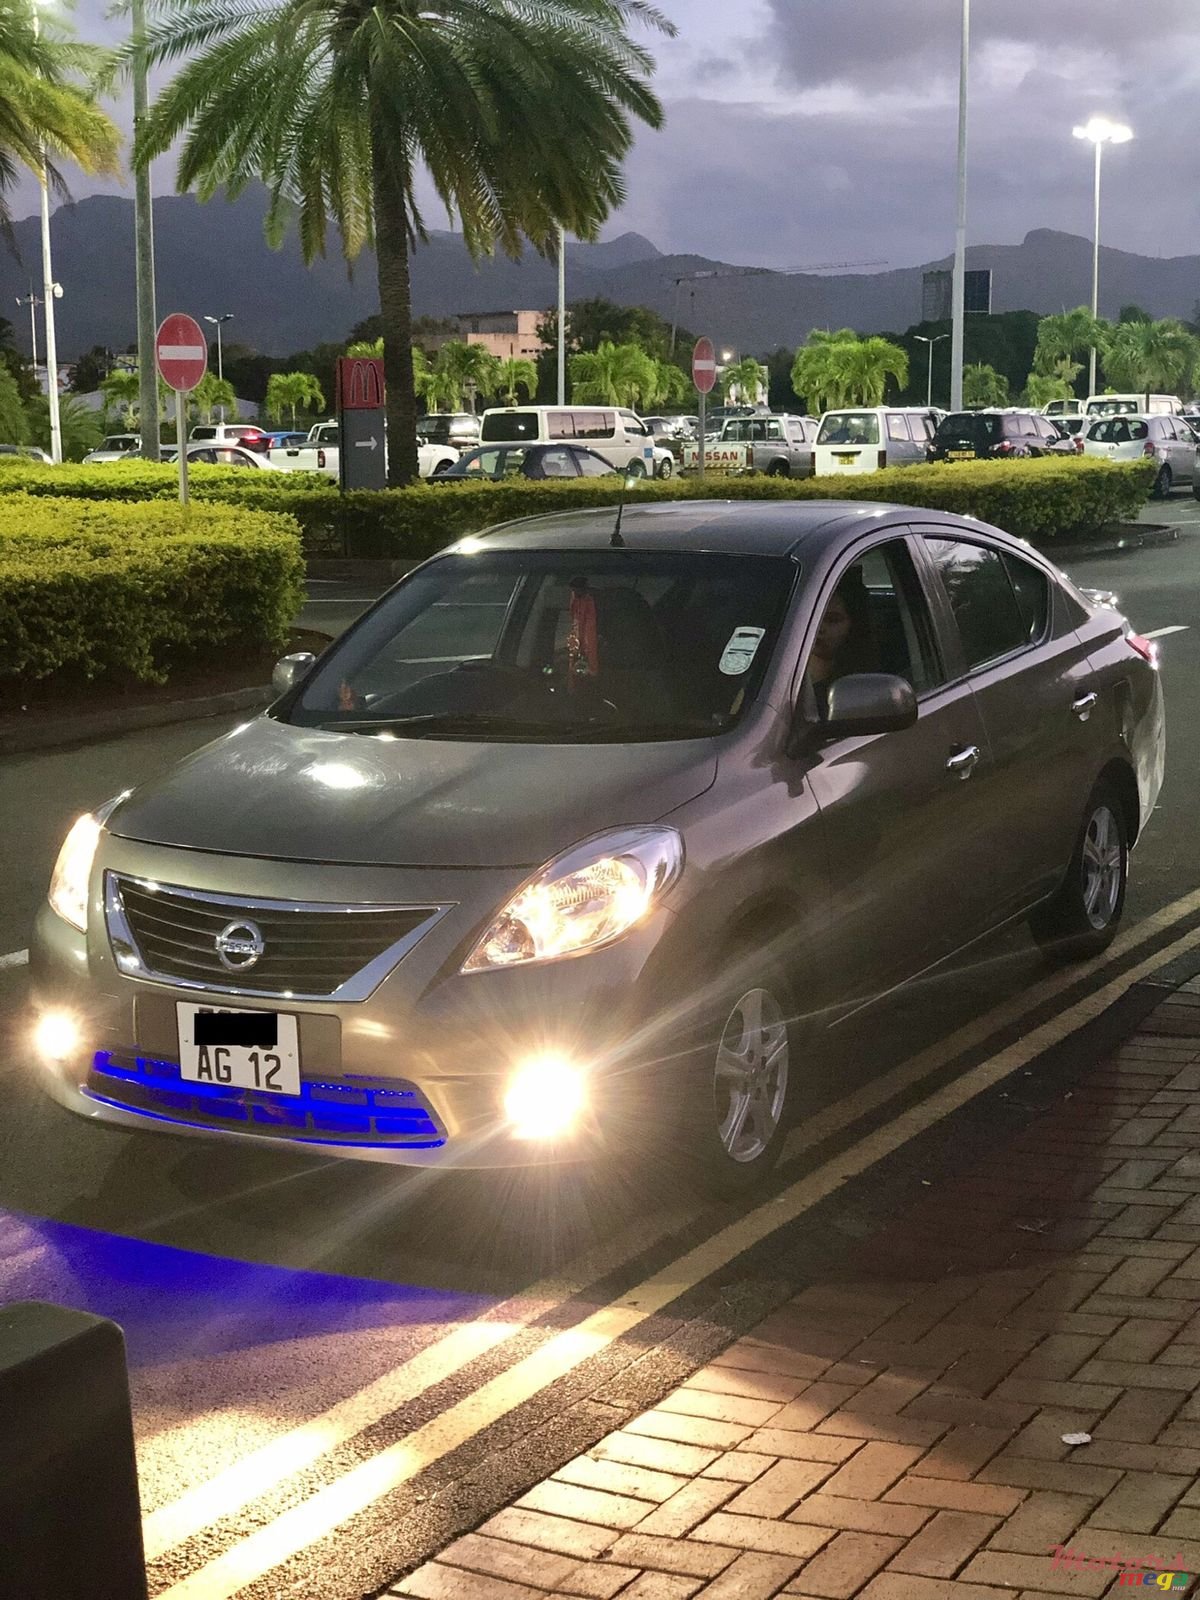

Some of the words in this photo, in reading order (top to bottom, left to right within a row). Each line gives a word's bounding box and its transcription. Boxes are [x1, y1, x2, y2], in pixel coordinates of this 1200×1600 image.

[691, 451, 738, 461] NSSAN
[197, 1046, 232, 1083] AG
[248, 1052, 282, 1091] 12
